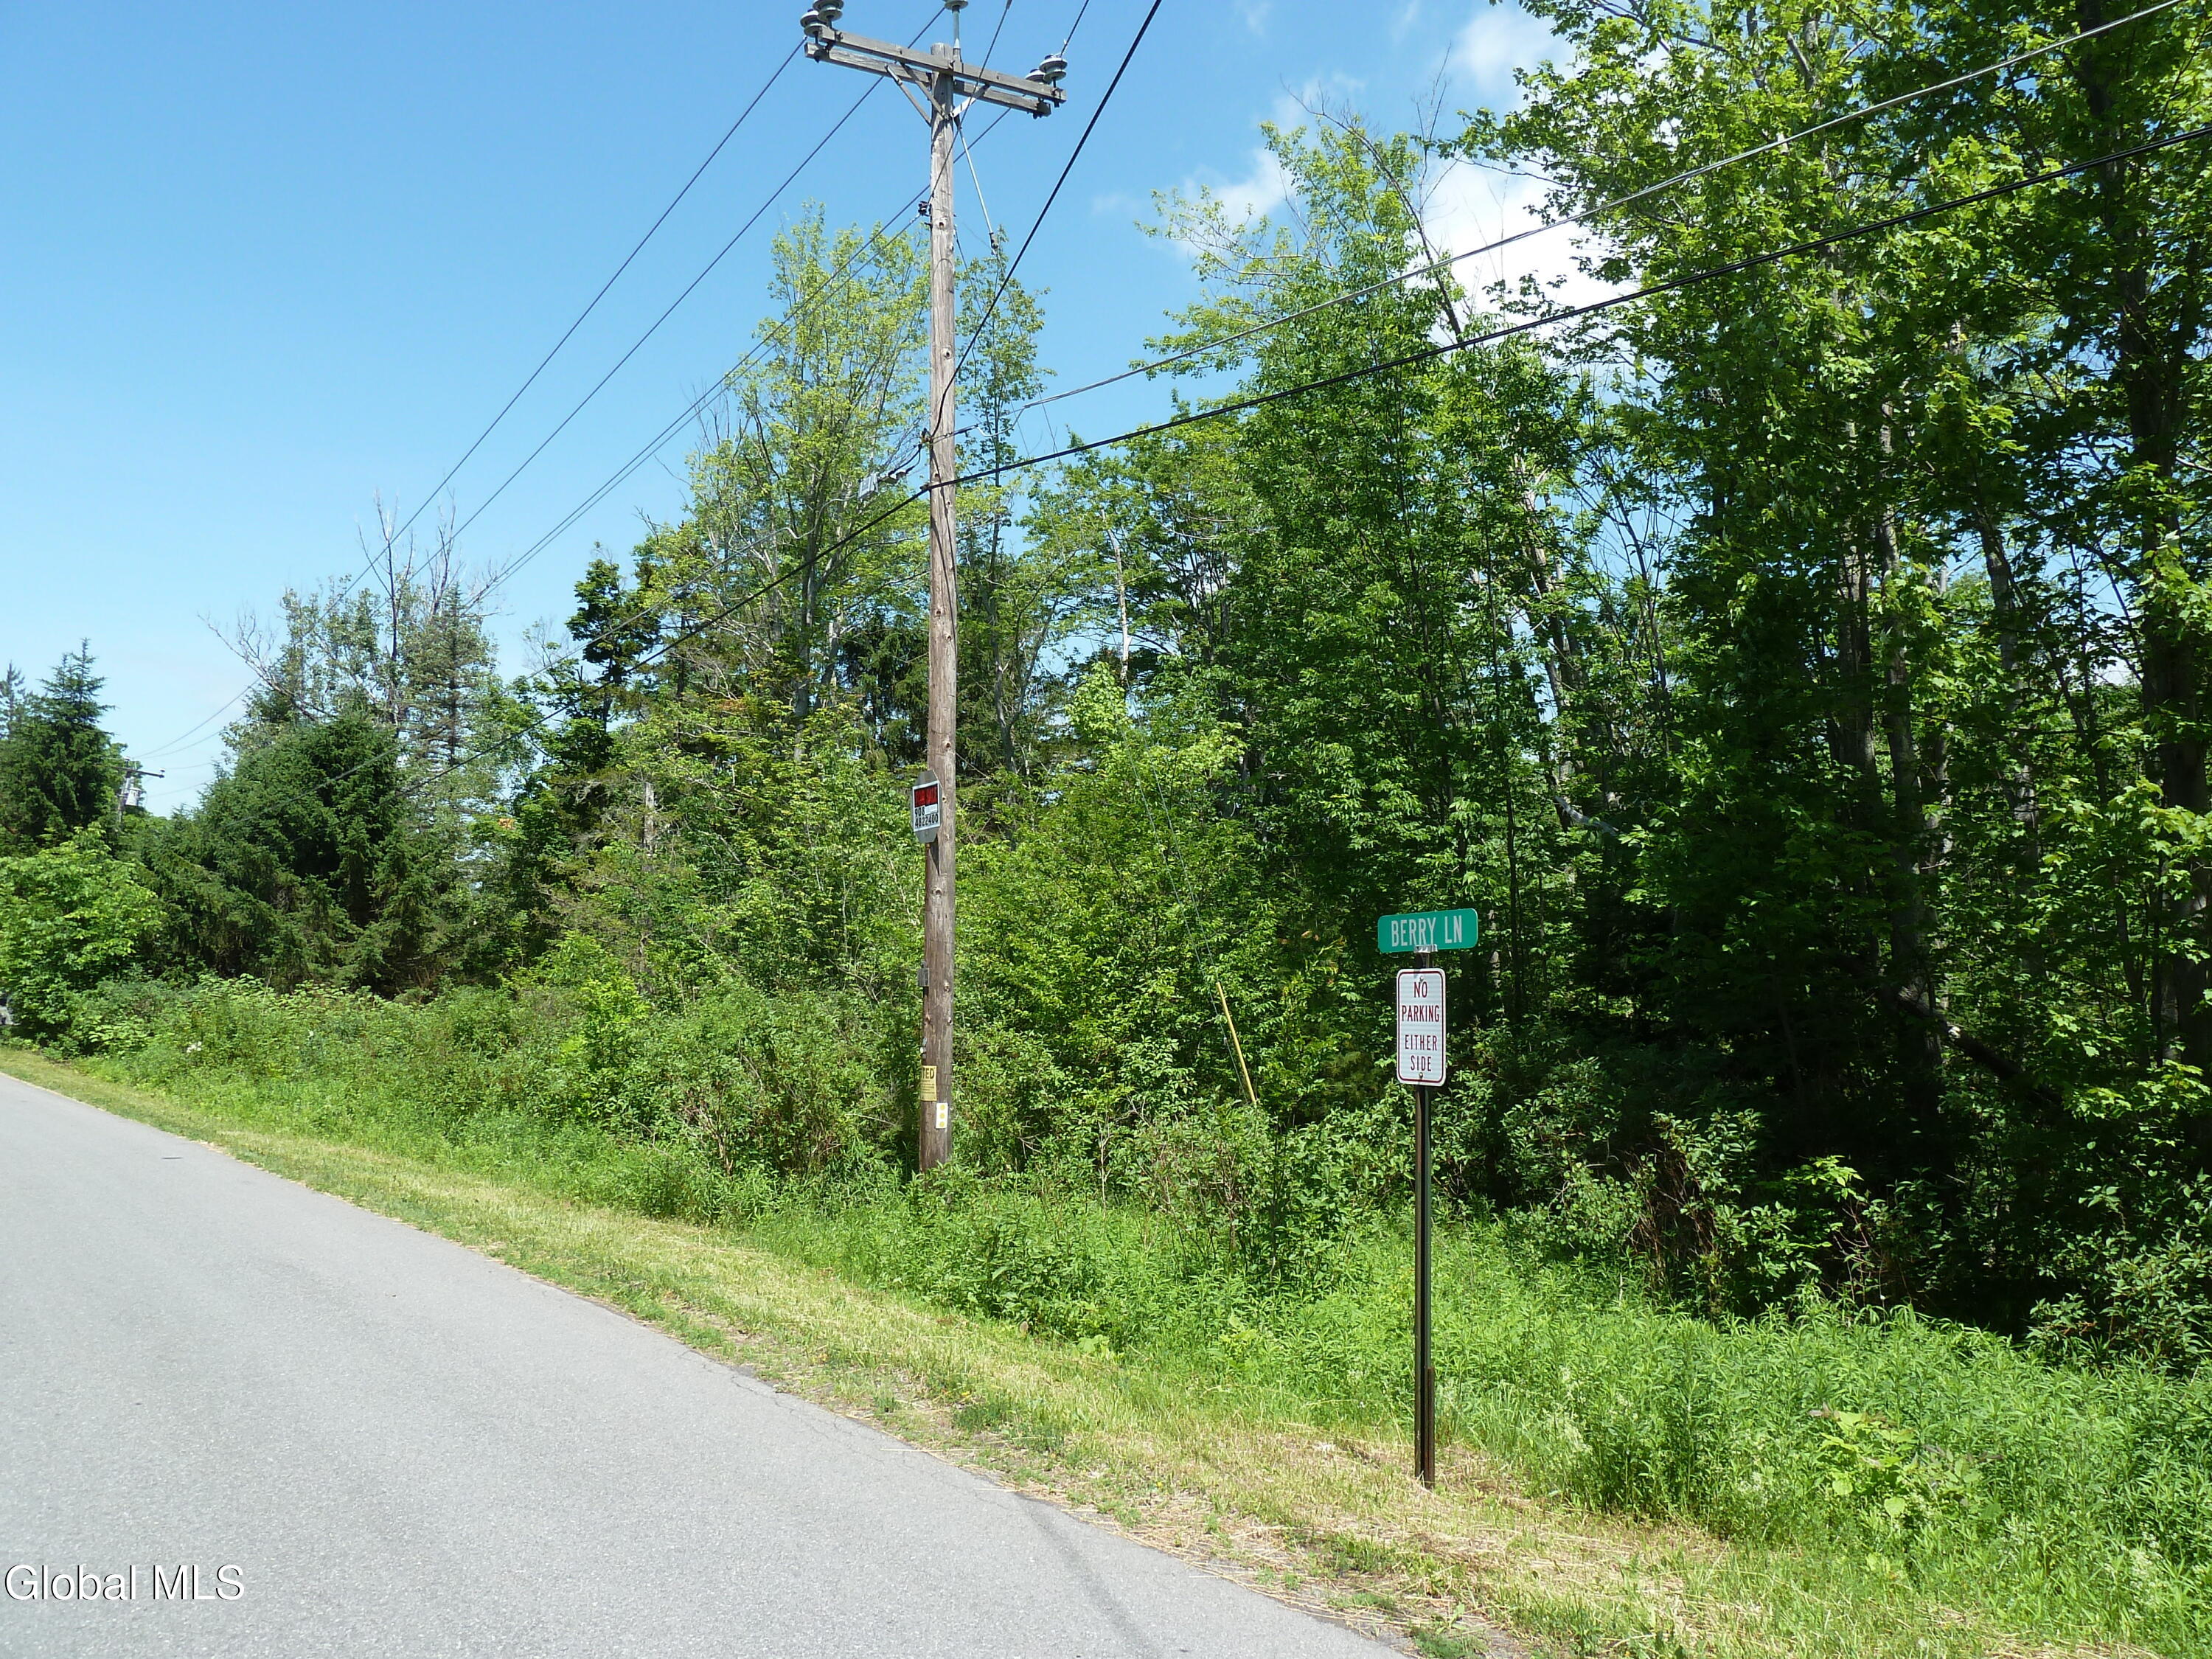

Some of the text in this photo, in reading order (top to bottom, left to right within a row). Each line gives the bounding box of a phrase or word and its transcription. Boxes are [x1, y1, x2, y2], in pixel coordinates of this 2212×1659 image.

[915, 814, 939, 827] 4822400
[1391, 915, 1462, 947] BERRY LN
[1413, 981, 1428, 998] NO
[1402, 1005, 1440, 1022] PARKING
[1405, 1034, 1437, 1051] EITHER
[1411, 1055, 1432, 1071] SIDE
